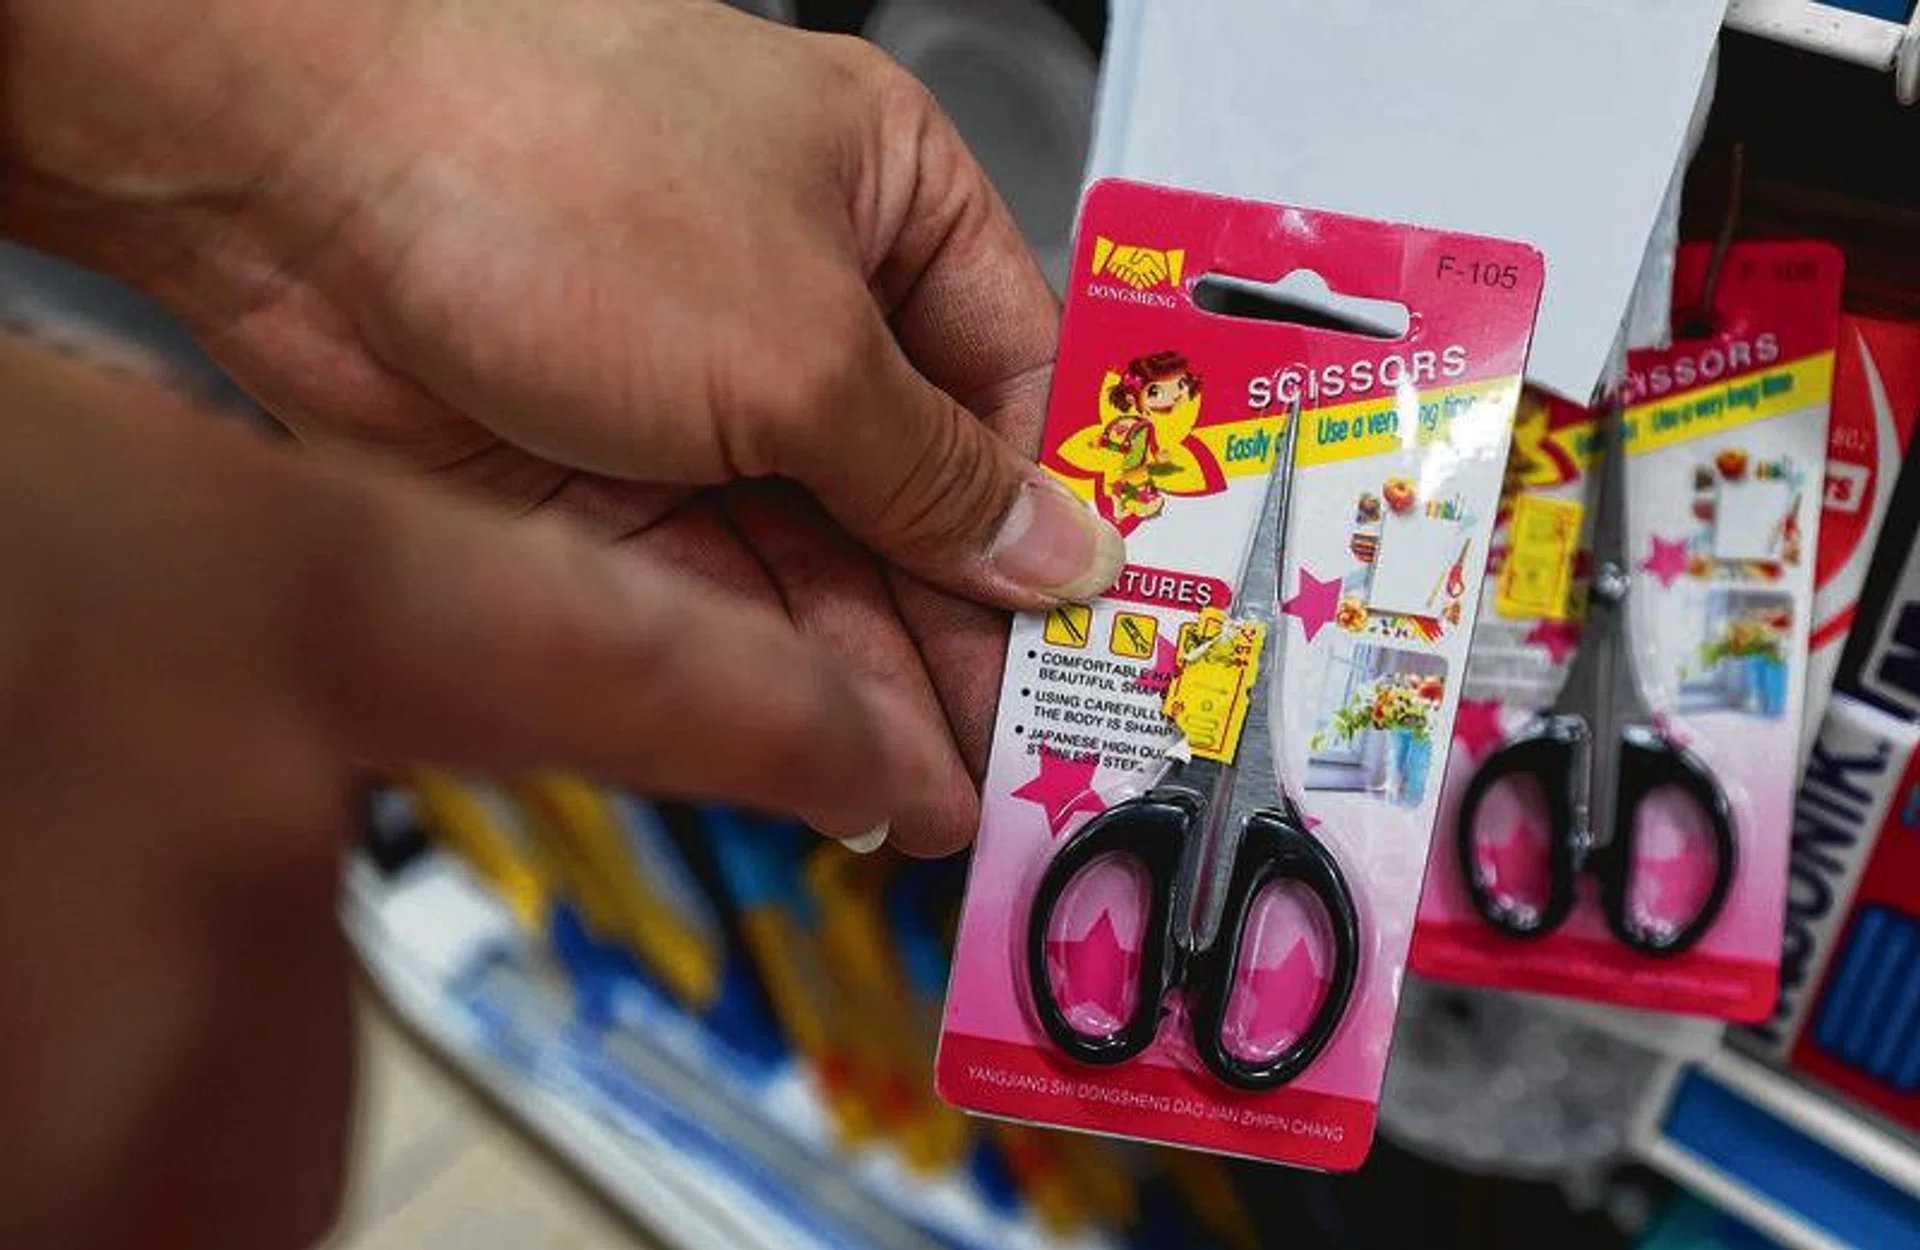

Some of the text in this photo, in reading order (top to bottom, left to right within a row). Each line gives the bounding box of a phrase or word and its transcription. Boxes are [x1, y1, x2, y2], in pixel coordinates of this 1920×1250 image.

[1436, 256, 1519, 289] F-105
[1087, 283, 1178, 309] DONGSHENG
[1247, 344, 1468, 410] SCISSORS
[1317, 417, 1349, 445] Use
[1353, 419, 1363, 438] a
[1224, 427, 1270, 463] Easily
[1039, 667, 1117, 692] BEAUTIFUL
[1041, 652, 1149, 680] COMFORTABLE
[1035, 690, 1081, 708] USING
[1034, 705, 1062, 721] THE
[1063, 711, 1104, 727] BODY
[1106, 718, 1122, 731] IS
[1026, 743, 1101, 766] STAINLESS
[1028, 728, 1100, 750] JAPANESE
[1102, 739, 1137, 755] HIGH
[967, 1065, 1048, 1094] YANGJIANG
[1050, 1077, 1077, 1096] SHI
[1077, 1083, 1171, 1113] DONGSHENG
[1207, 1104, 1240, 1123] JIAN
[1291, 1119, 1345, 1142] CHANG
